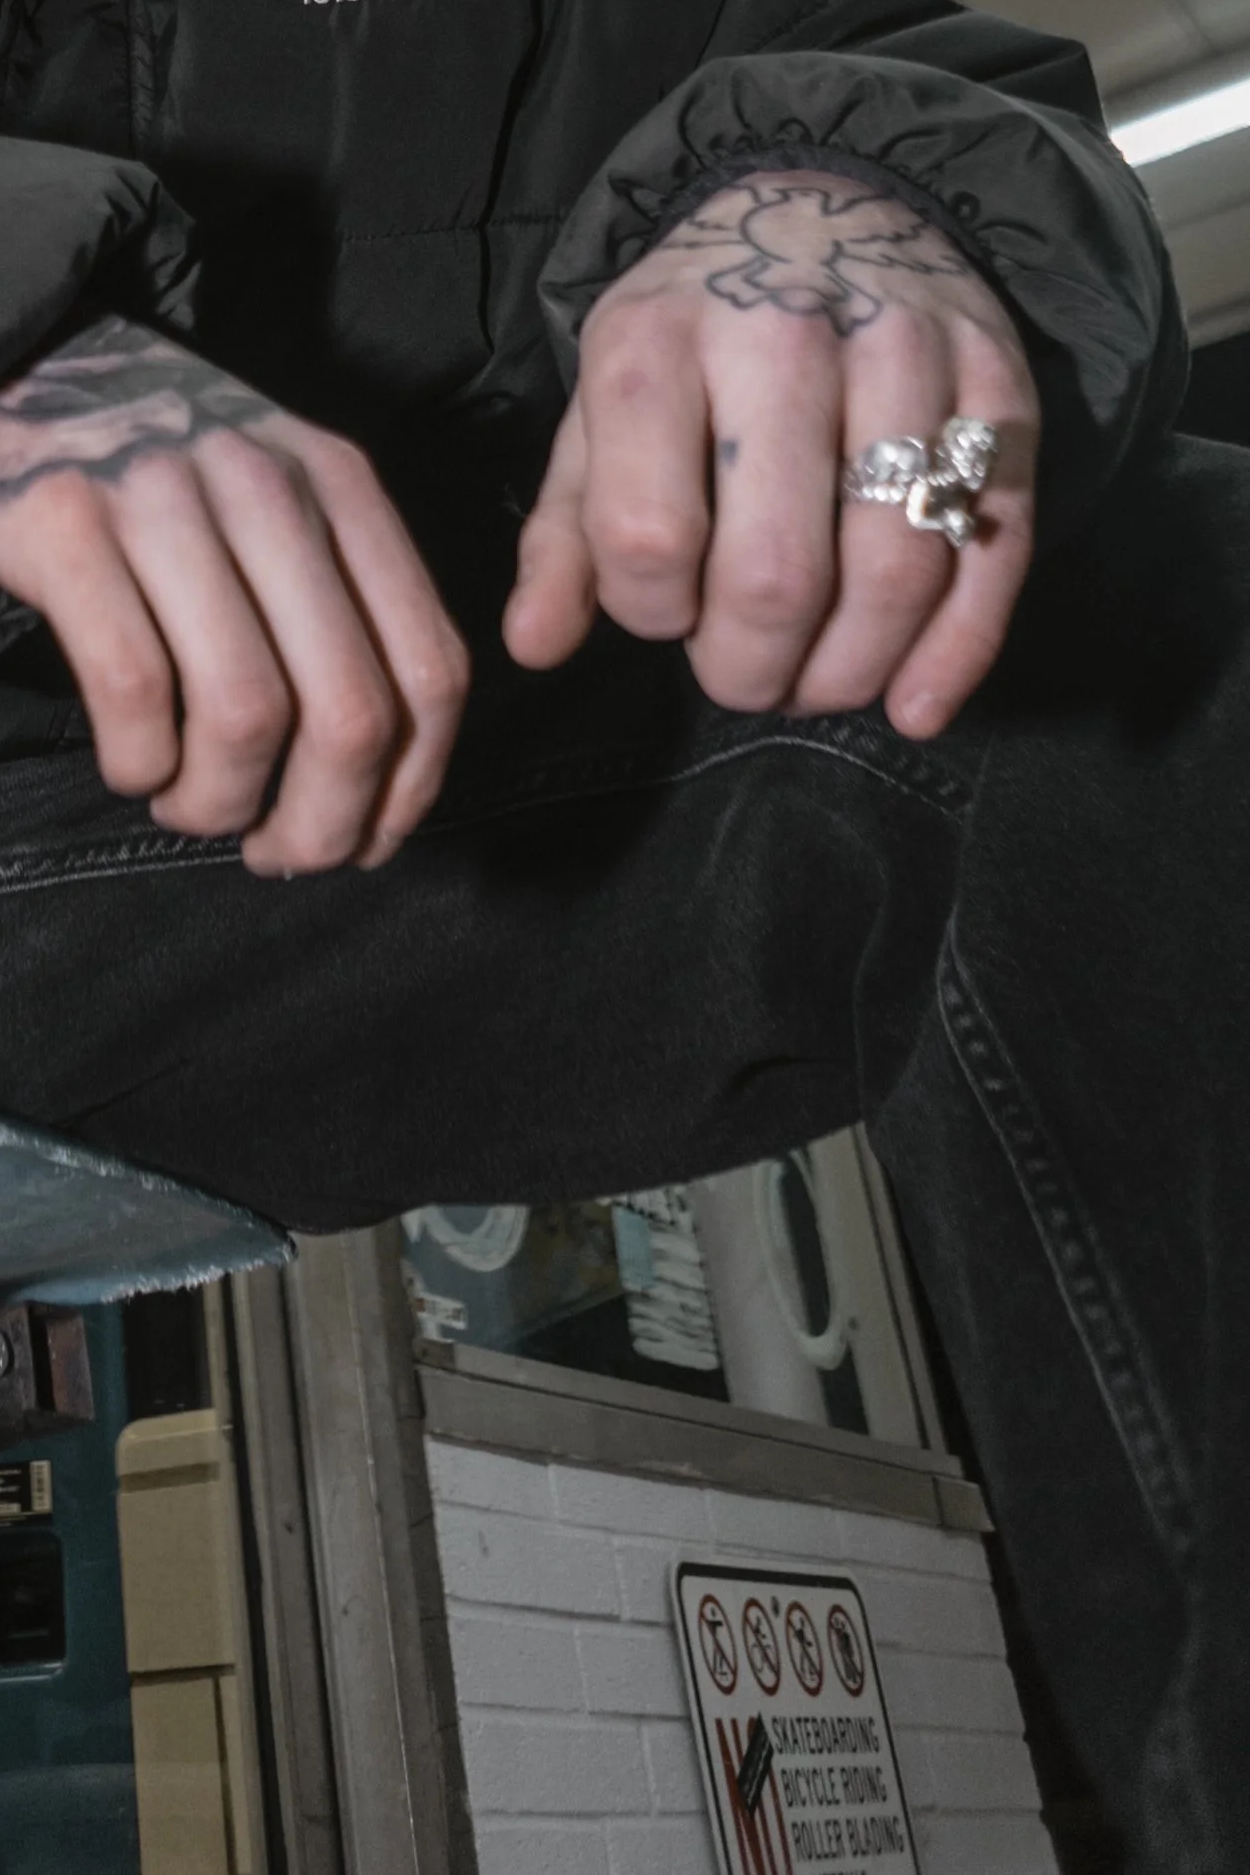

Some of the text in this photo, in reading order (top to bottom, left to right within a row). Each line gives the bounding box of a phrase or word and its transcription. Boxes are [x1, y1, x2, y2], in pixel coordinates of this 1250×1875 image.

[771, 1716, 880, 1755] SKATEBOARDING
[781, 1766, 888, 1808] BICYCLE RIDING
[791, 1815, 904, 1862] ROLLER BLADING
